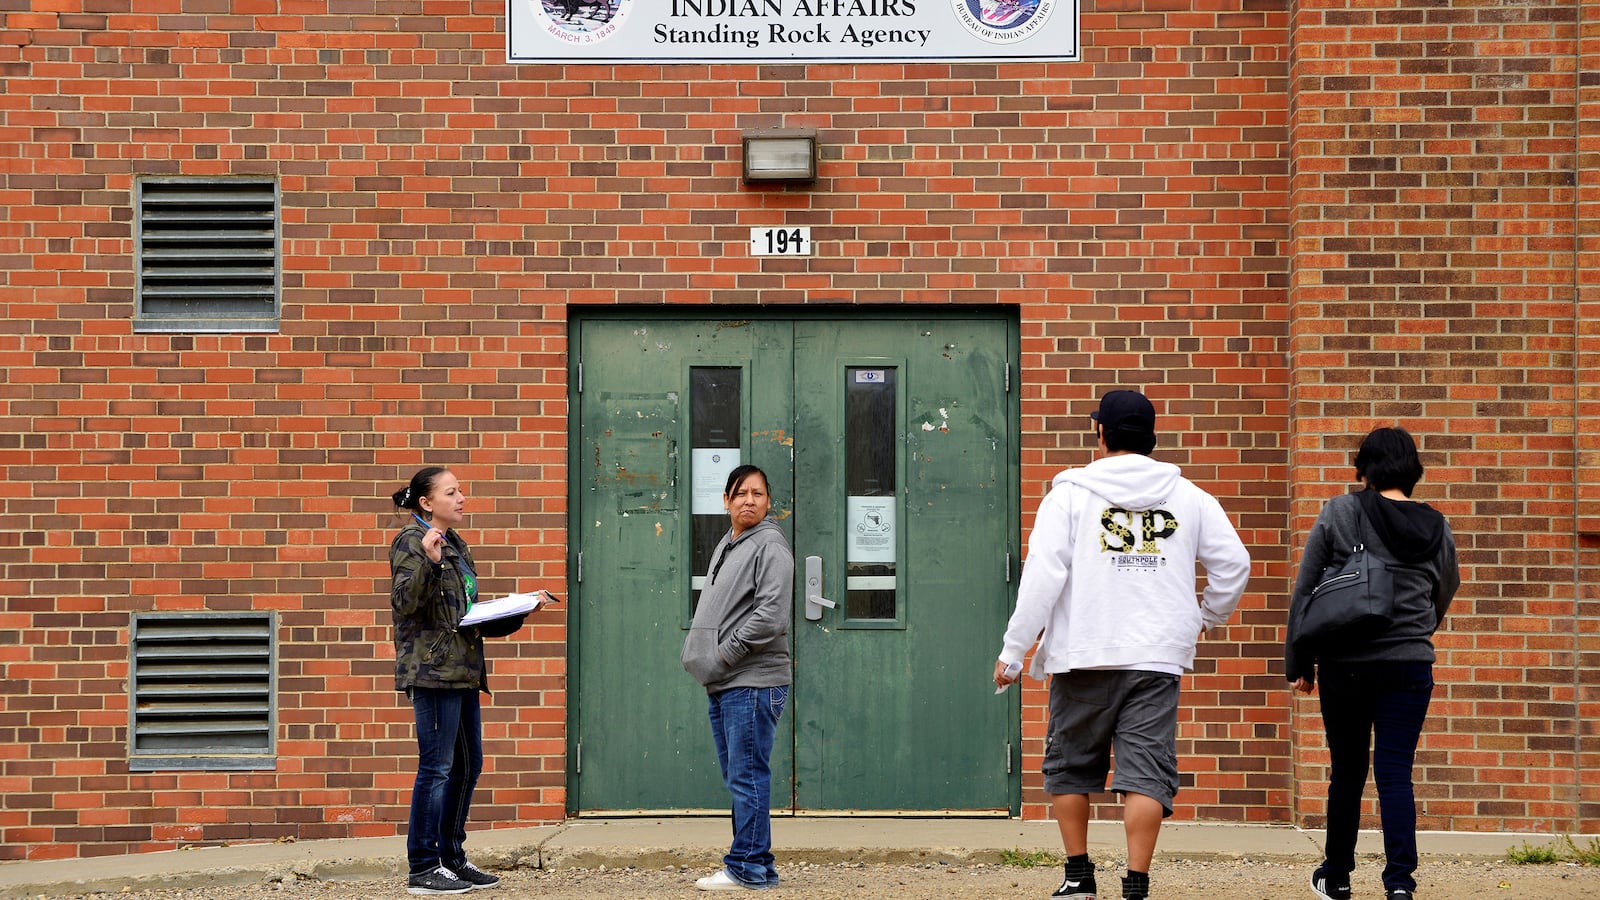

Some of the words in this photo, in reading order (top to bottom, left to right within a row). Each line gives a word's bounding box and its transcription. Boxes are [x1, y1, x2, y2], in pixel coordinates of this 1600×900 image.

[670, 0, 783, 17] INDIAN
[792, 0, 916, 17] AFFAIRS
[956, 3, 983, 32] BUREAU
[981, 28, 994, 38] OF
[994, 30, 1025, 40] INDIAN
[1025, 2, 1050, 34] AFFAIRS
[547, 25, 581, 43] MARCH
[596, 23, 616, 40] 1849
[654, 23, 760, 48] Standing
[767, 22, 832, 43] Rock
[840, 23, 931, 48] Agency
[765, 228, 804, 254] 194
[1099, 507, 1178, 554] SP
